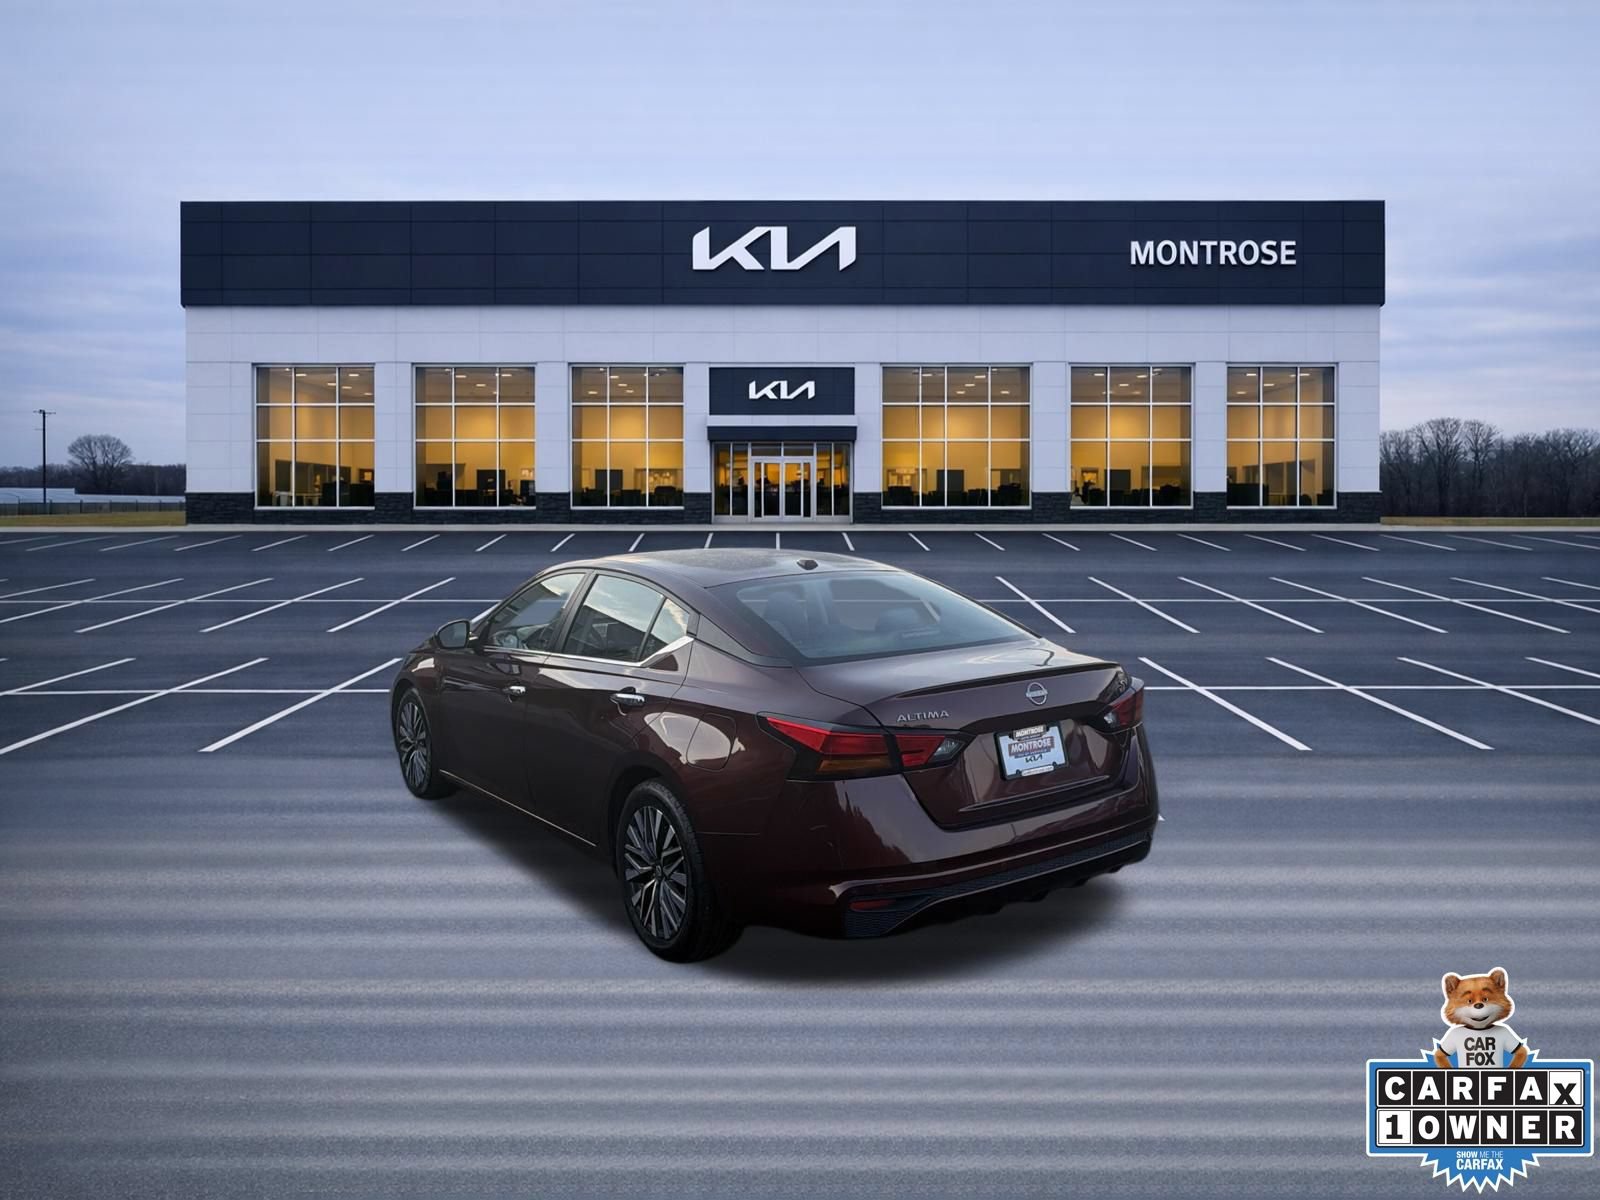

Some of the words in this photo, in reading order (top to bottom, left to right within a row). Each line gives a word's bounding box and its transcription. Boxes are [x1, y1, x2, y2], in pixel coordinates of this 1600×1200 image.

[692, 226, 856, 271] KIA
[1130, 240, 1297, 265] MONTROSE
[748, 380, 815, 399] KIA
[897, 710, 949, 722] ALTIMA
[1015, 726, 1044, 738] MONTROSE
[1011, 738, 1052, 753] MONTROSE
